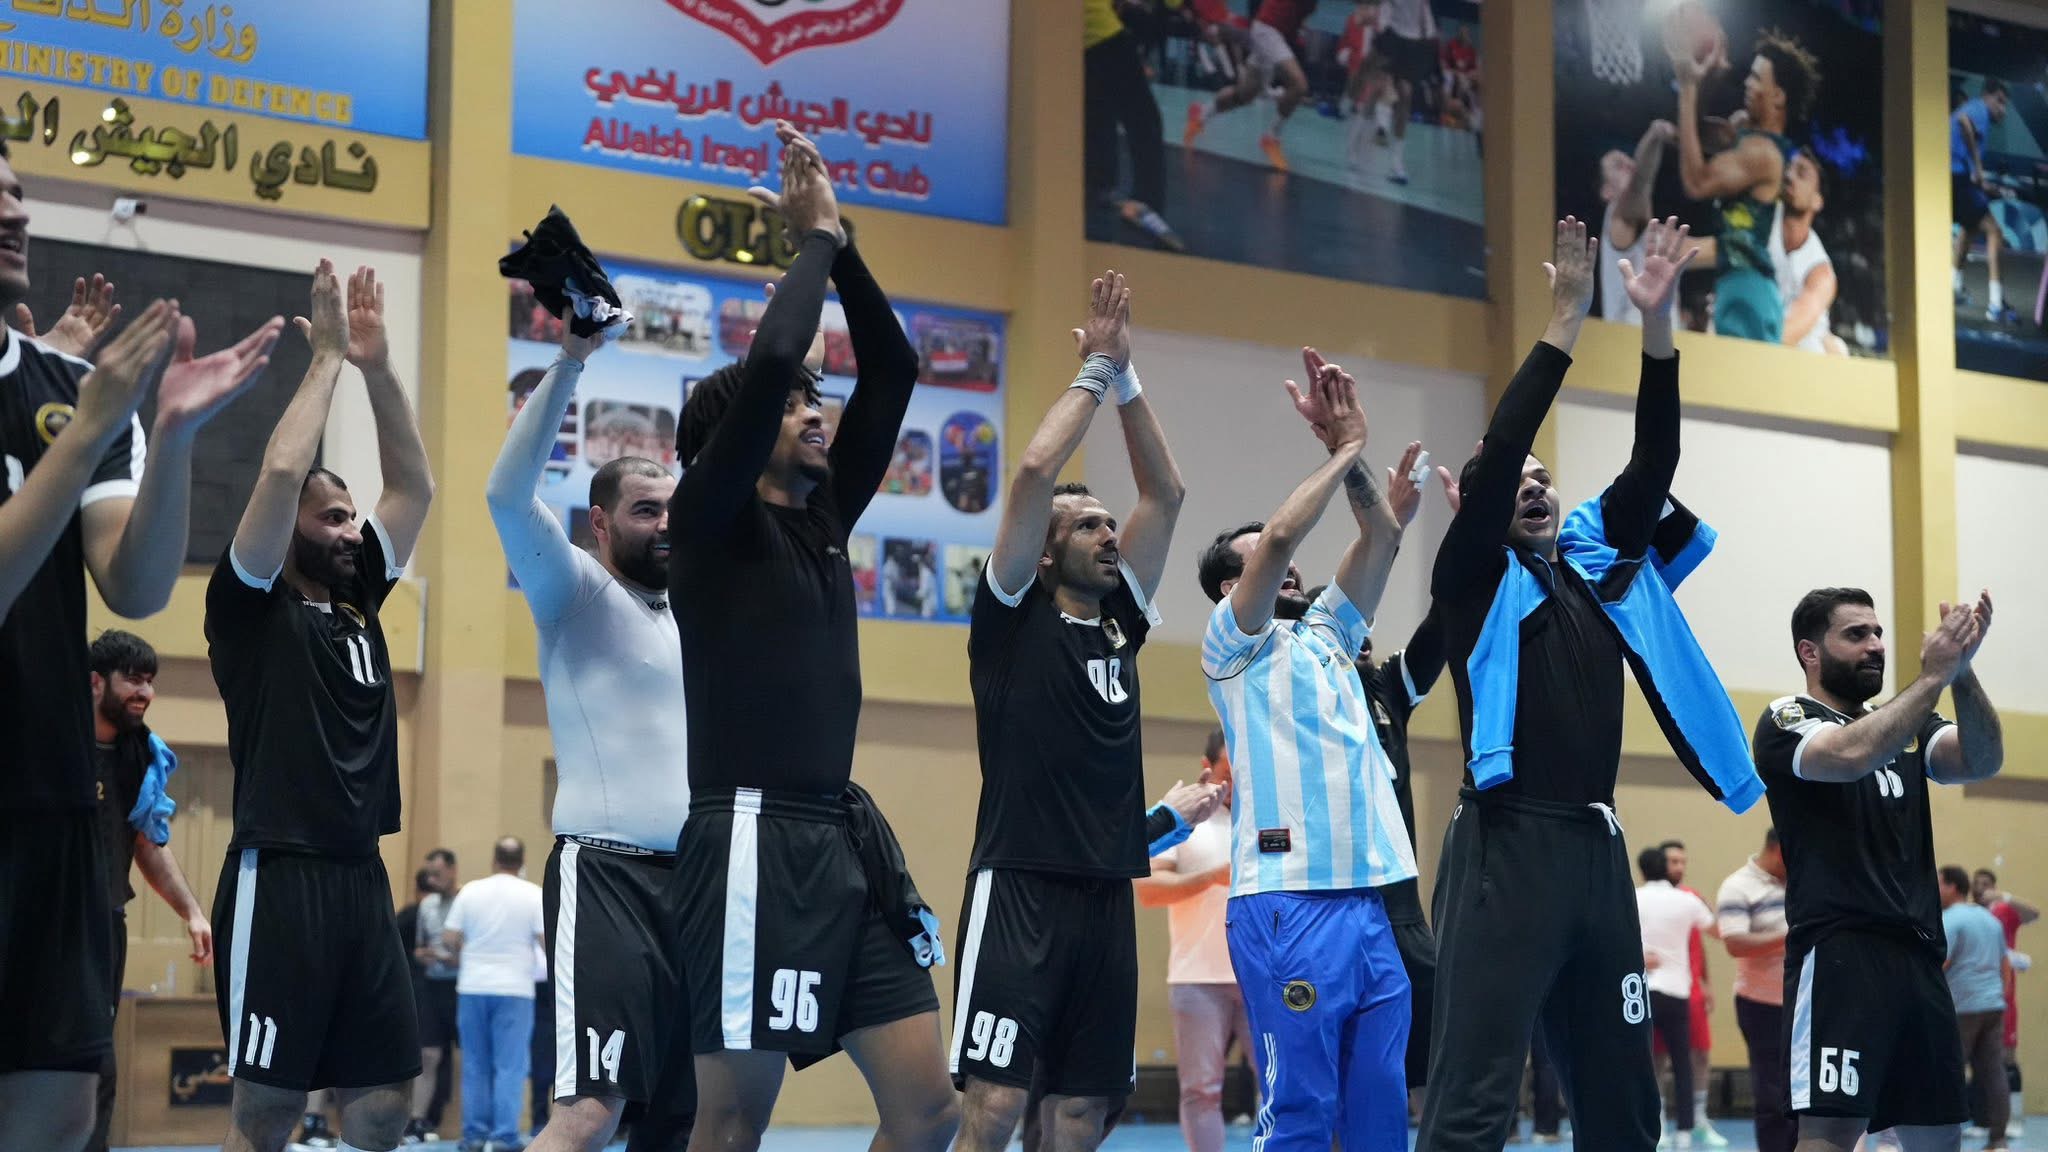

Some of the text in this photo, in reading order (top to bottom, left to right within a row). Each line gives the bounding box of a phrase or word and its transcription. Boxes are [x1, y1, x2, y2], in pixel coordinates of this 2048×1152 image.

[159, 0, 258, 64] وزارة
[162, 65, 202, 100] OF
[209, 73, 354, 124] DEFENCE
[585, 67, 732, 116] الرياضي
[68, 97, 239, 180] الجيش
[249, 139, 378, 201] نادي
[865, 158, 930, 196] Club
[346, 634, 376, 685] 11
[1086, 657, 1129, 704] 98
[768, 968, 822, 1033] 96
[244, 1012, 278, 1069] 11
[586, 1026, 626, 1083] 14
[966, 1010, 1019, 1068] 98
[1818, 1046, 1860, 1096] 66
